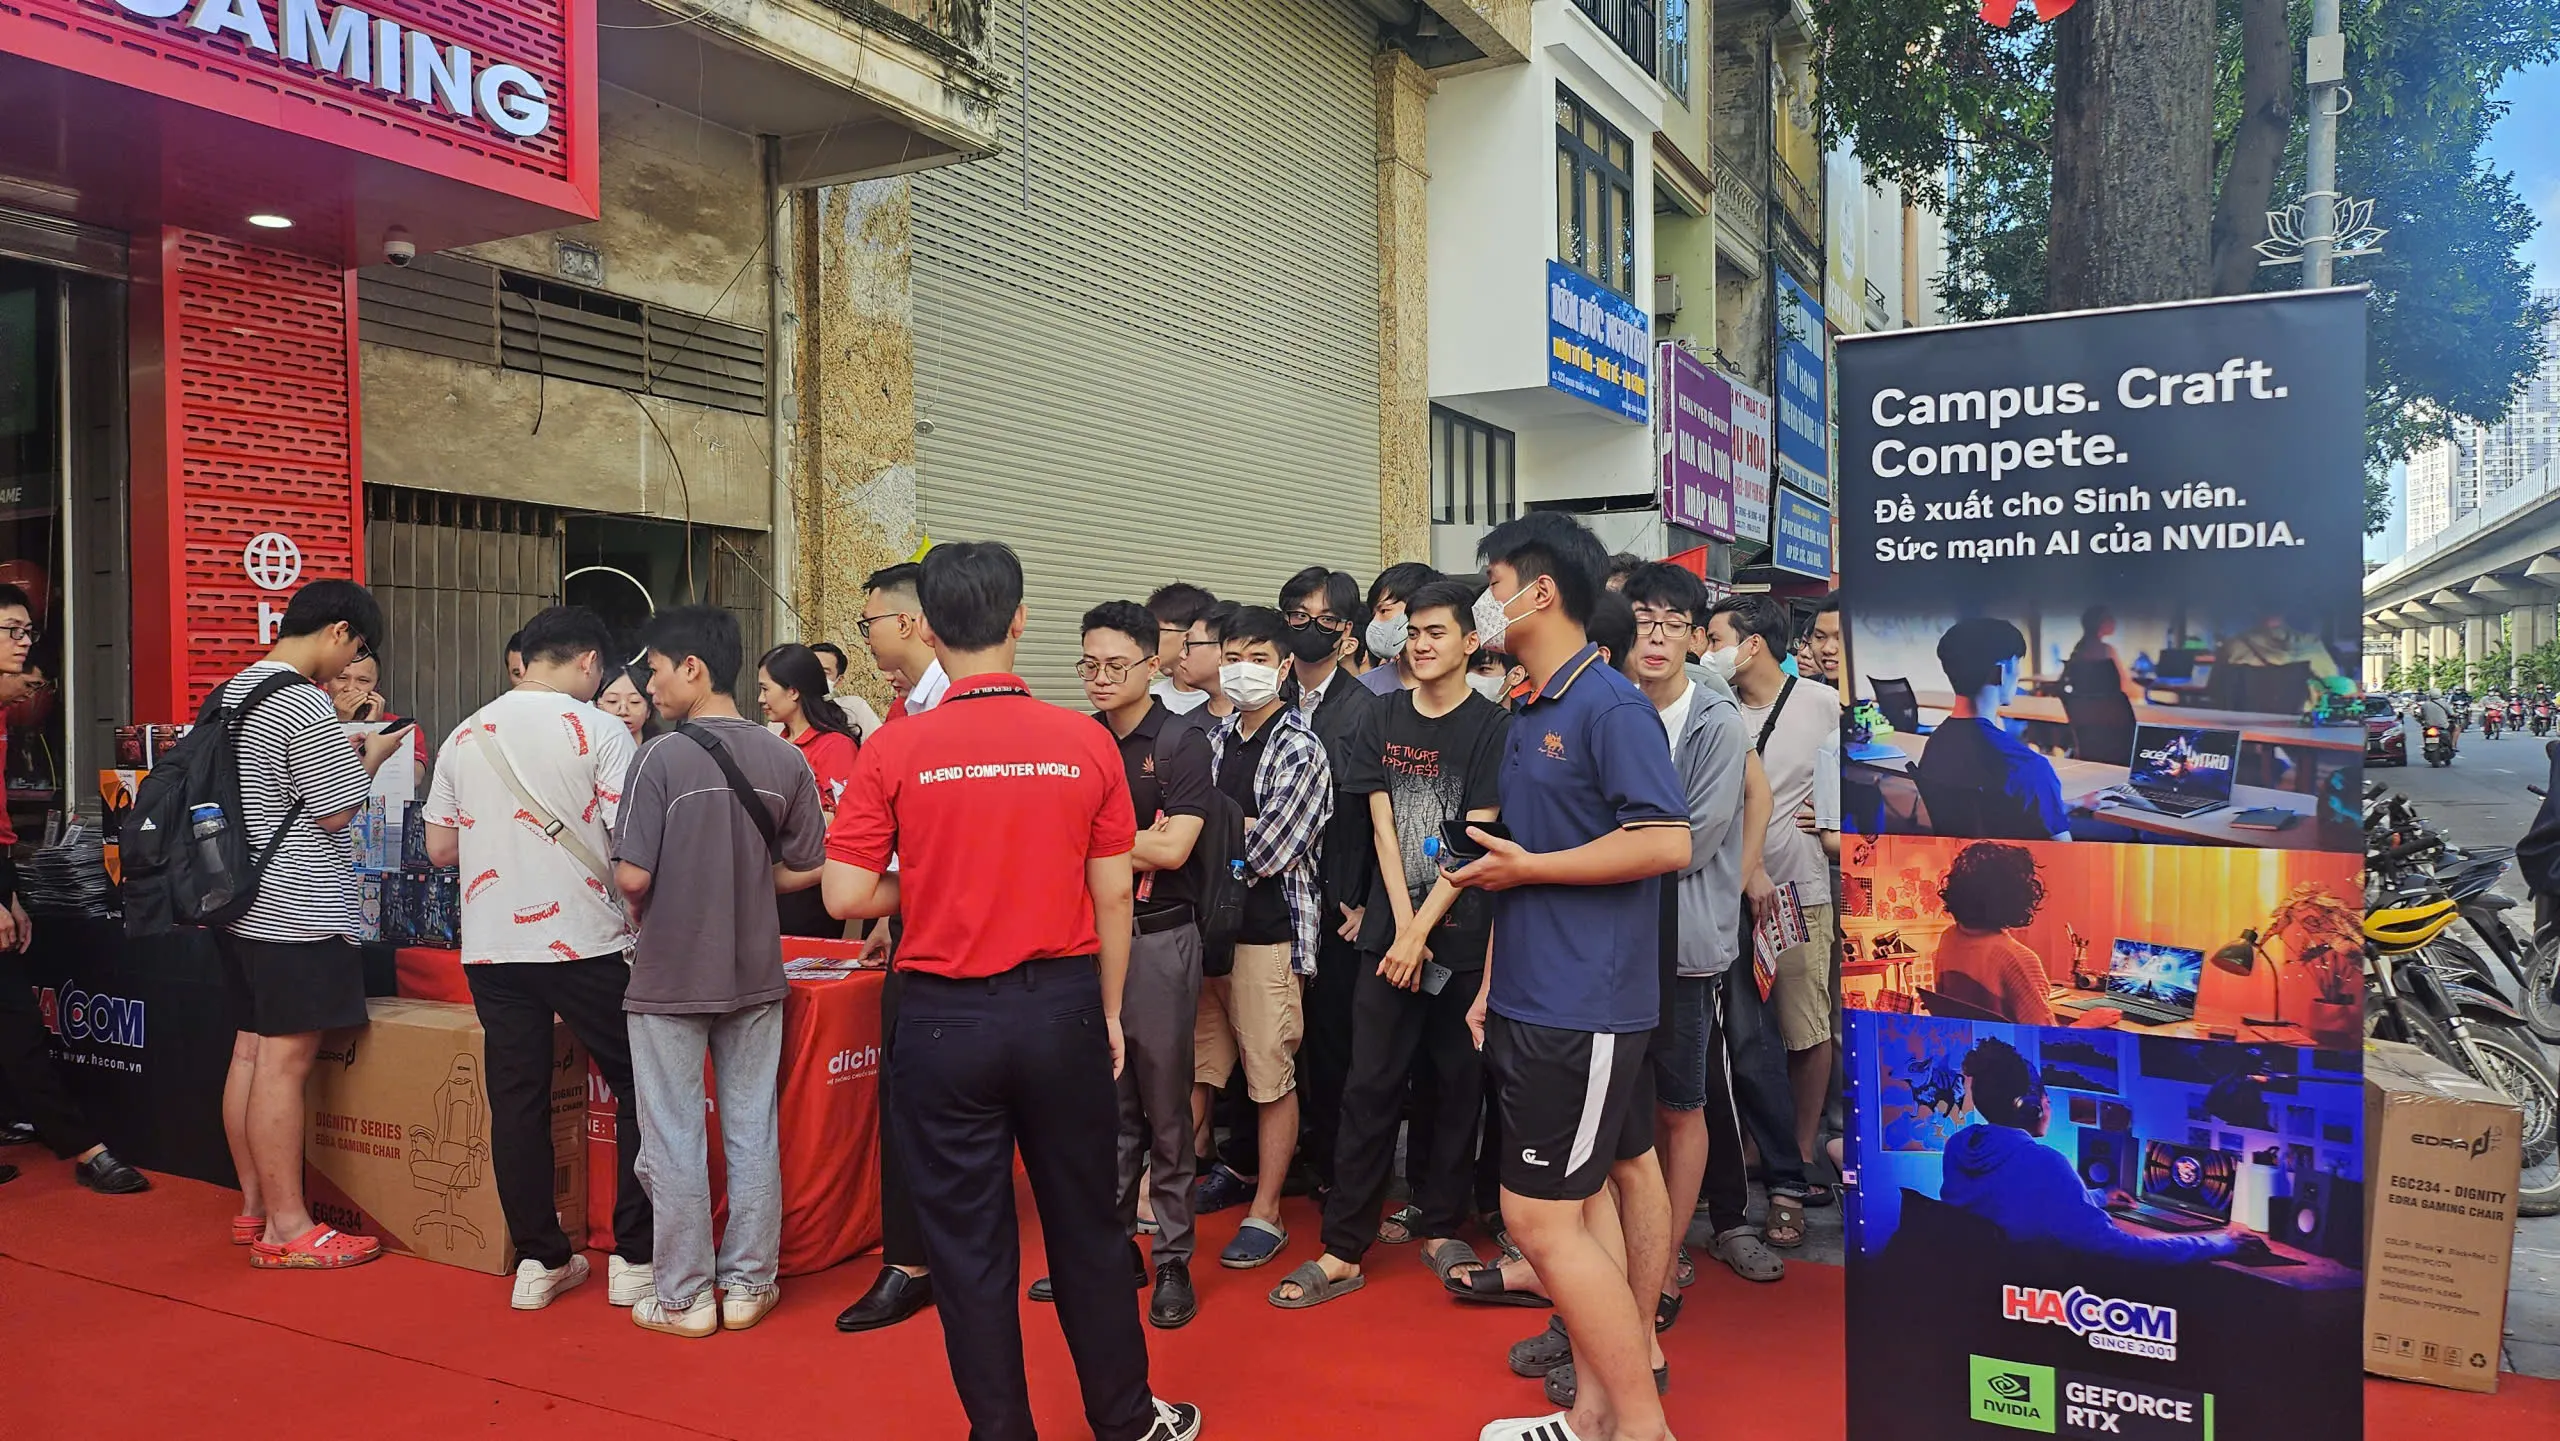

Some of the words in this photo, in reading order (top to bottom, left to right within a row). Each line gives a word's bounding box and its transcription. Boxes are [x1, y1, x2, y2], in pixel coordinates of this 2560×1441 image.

[115, 0, 550, 137] AMING
[1871, 382, 2100, 429] Campus.
[2117, 357, 2288, 410] Craft.
[1680, 428, 1696, 467] HOA
[1697, 435, 1713, 476] QUẢ
[1746, 424, 1766, 473] HÒA
[1871, 428, 2128, 481] Compete.
[1685, 483, 1706, 527] NHẬP
[1874, 493, 1916, 524] Đề
[1924, 489, 1994, 521] xuất
[2002, 491, 2064, 518] cho
[2073, 485, 2150, 514] Sinh
[2161, 481, 2247, 510] viên.
[1875, 536, 1938, 562] Sức
[1947, 531, 2036, 564] mạnh
[2044, 530, 2079, 555] AI
[2089, 522, 2152, 554] của
[2162, 520, 2305, 551] NVIDIA.
[919, 766, 963, 785] HI-END
[965, 763, 1035, 779] COMPUTER
[1036, 762, 1081, 779] WORLD
[2139, 748, 2171, 761] acer
[31, 978, 145, 1049] ACOM
[315, 1111, 358, 1134] DIGNITY
[360, 1119, 402, 1141] SERIES
[2411, 1133, 2469, 1150] EDRA
[337, 1137, 371, 1155] GAMING
[373, 1144, 401, 1160] CHAIR
[2388, 1194, 2418, 1207] EDRA
[2421, 1200, 2466, 1216] GAMING
[2469, 1207, 2504, 1221] CHAIR
[2391, 1175, 2441, 1194] EGC234
[2455, 1185, 2507, 1204] DIGNITY
[2002, 1285, 2178, 1344] HACOM
[2092, 1335, 2136, 1352] SINCE
[2138, 1343, 2174, 1359] 2001
[2065, 1382, 2193, 1423] GEFORCE
[2066, 1405, 2121, 1434] RTX
